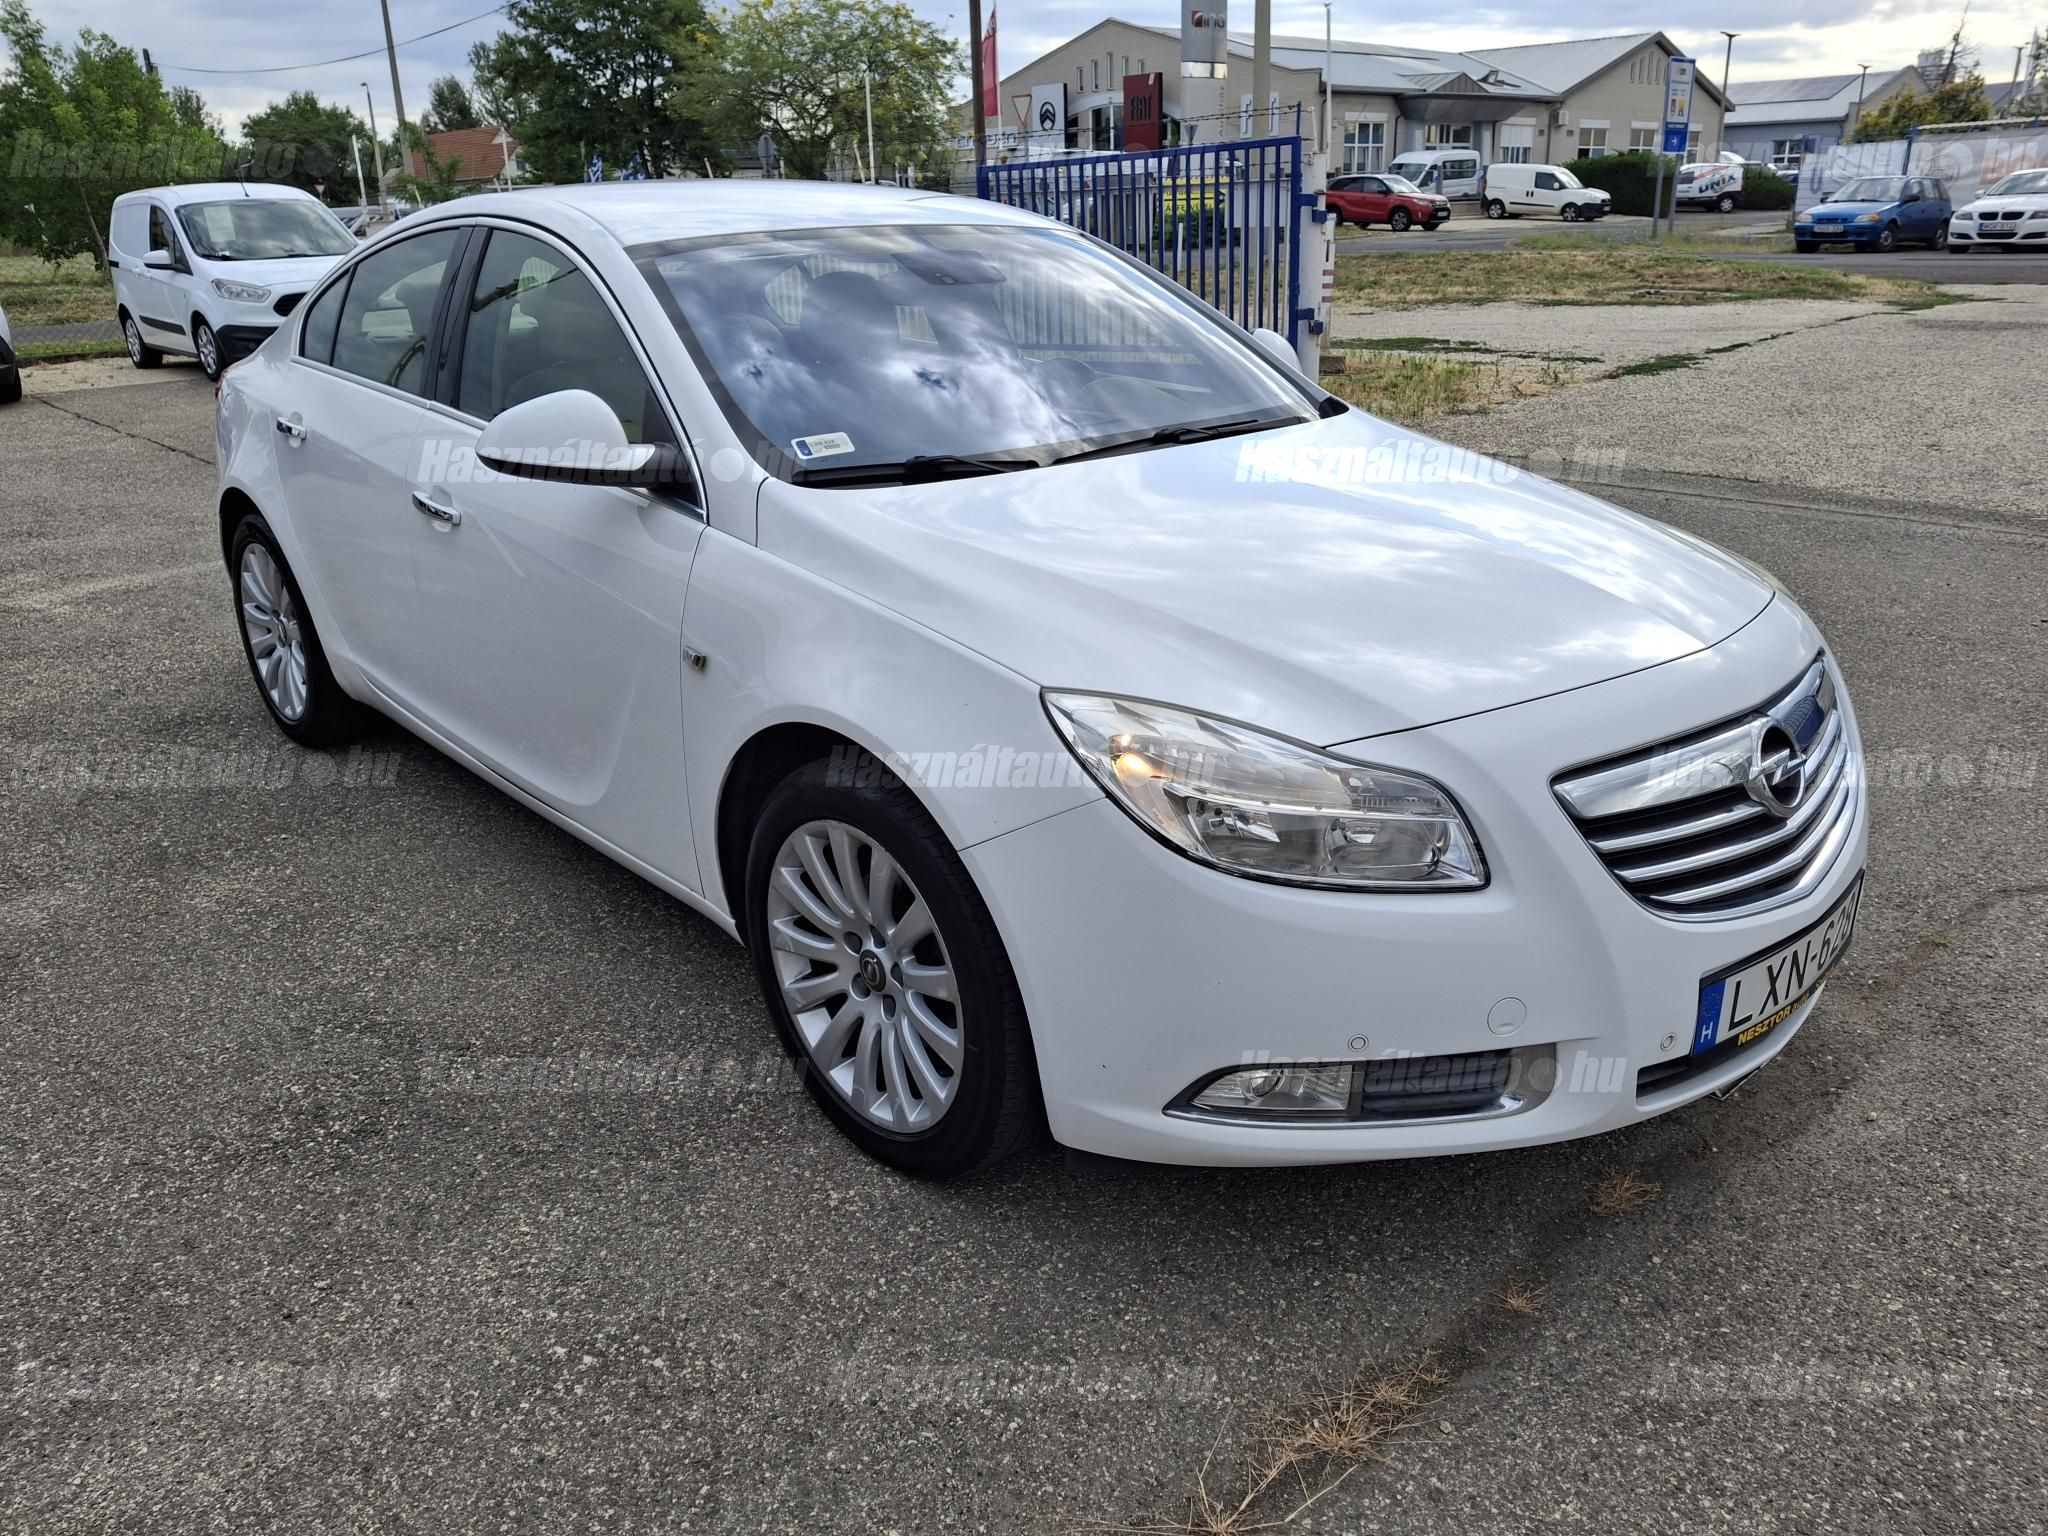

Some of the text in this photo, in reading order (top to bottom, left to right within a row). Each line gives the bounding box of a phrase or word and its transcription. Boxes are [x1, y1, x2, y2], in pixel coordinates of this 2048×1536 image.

[1698, 174, 1737, 194] UNIX
[1700, 1021, 1714, 1043] H
[1738, 1005, 1792, 1046] NESZTOR
